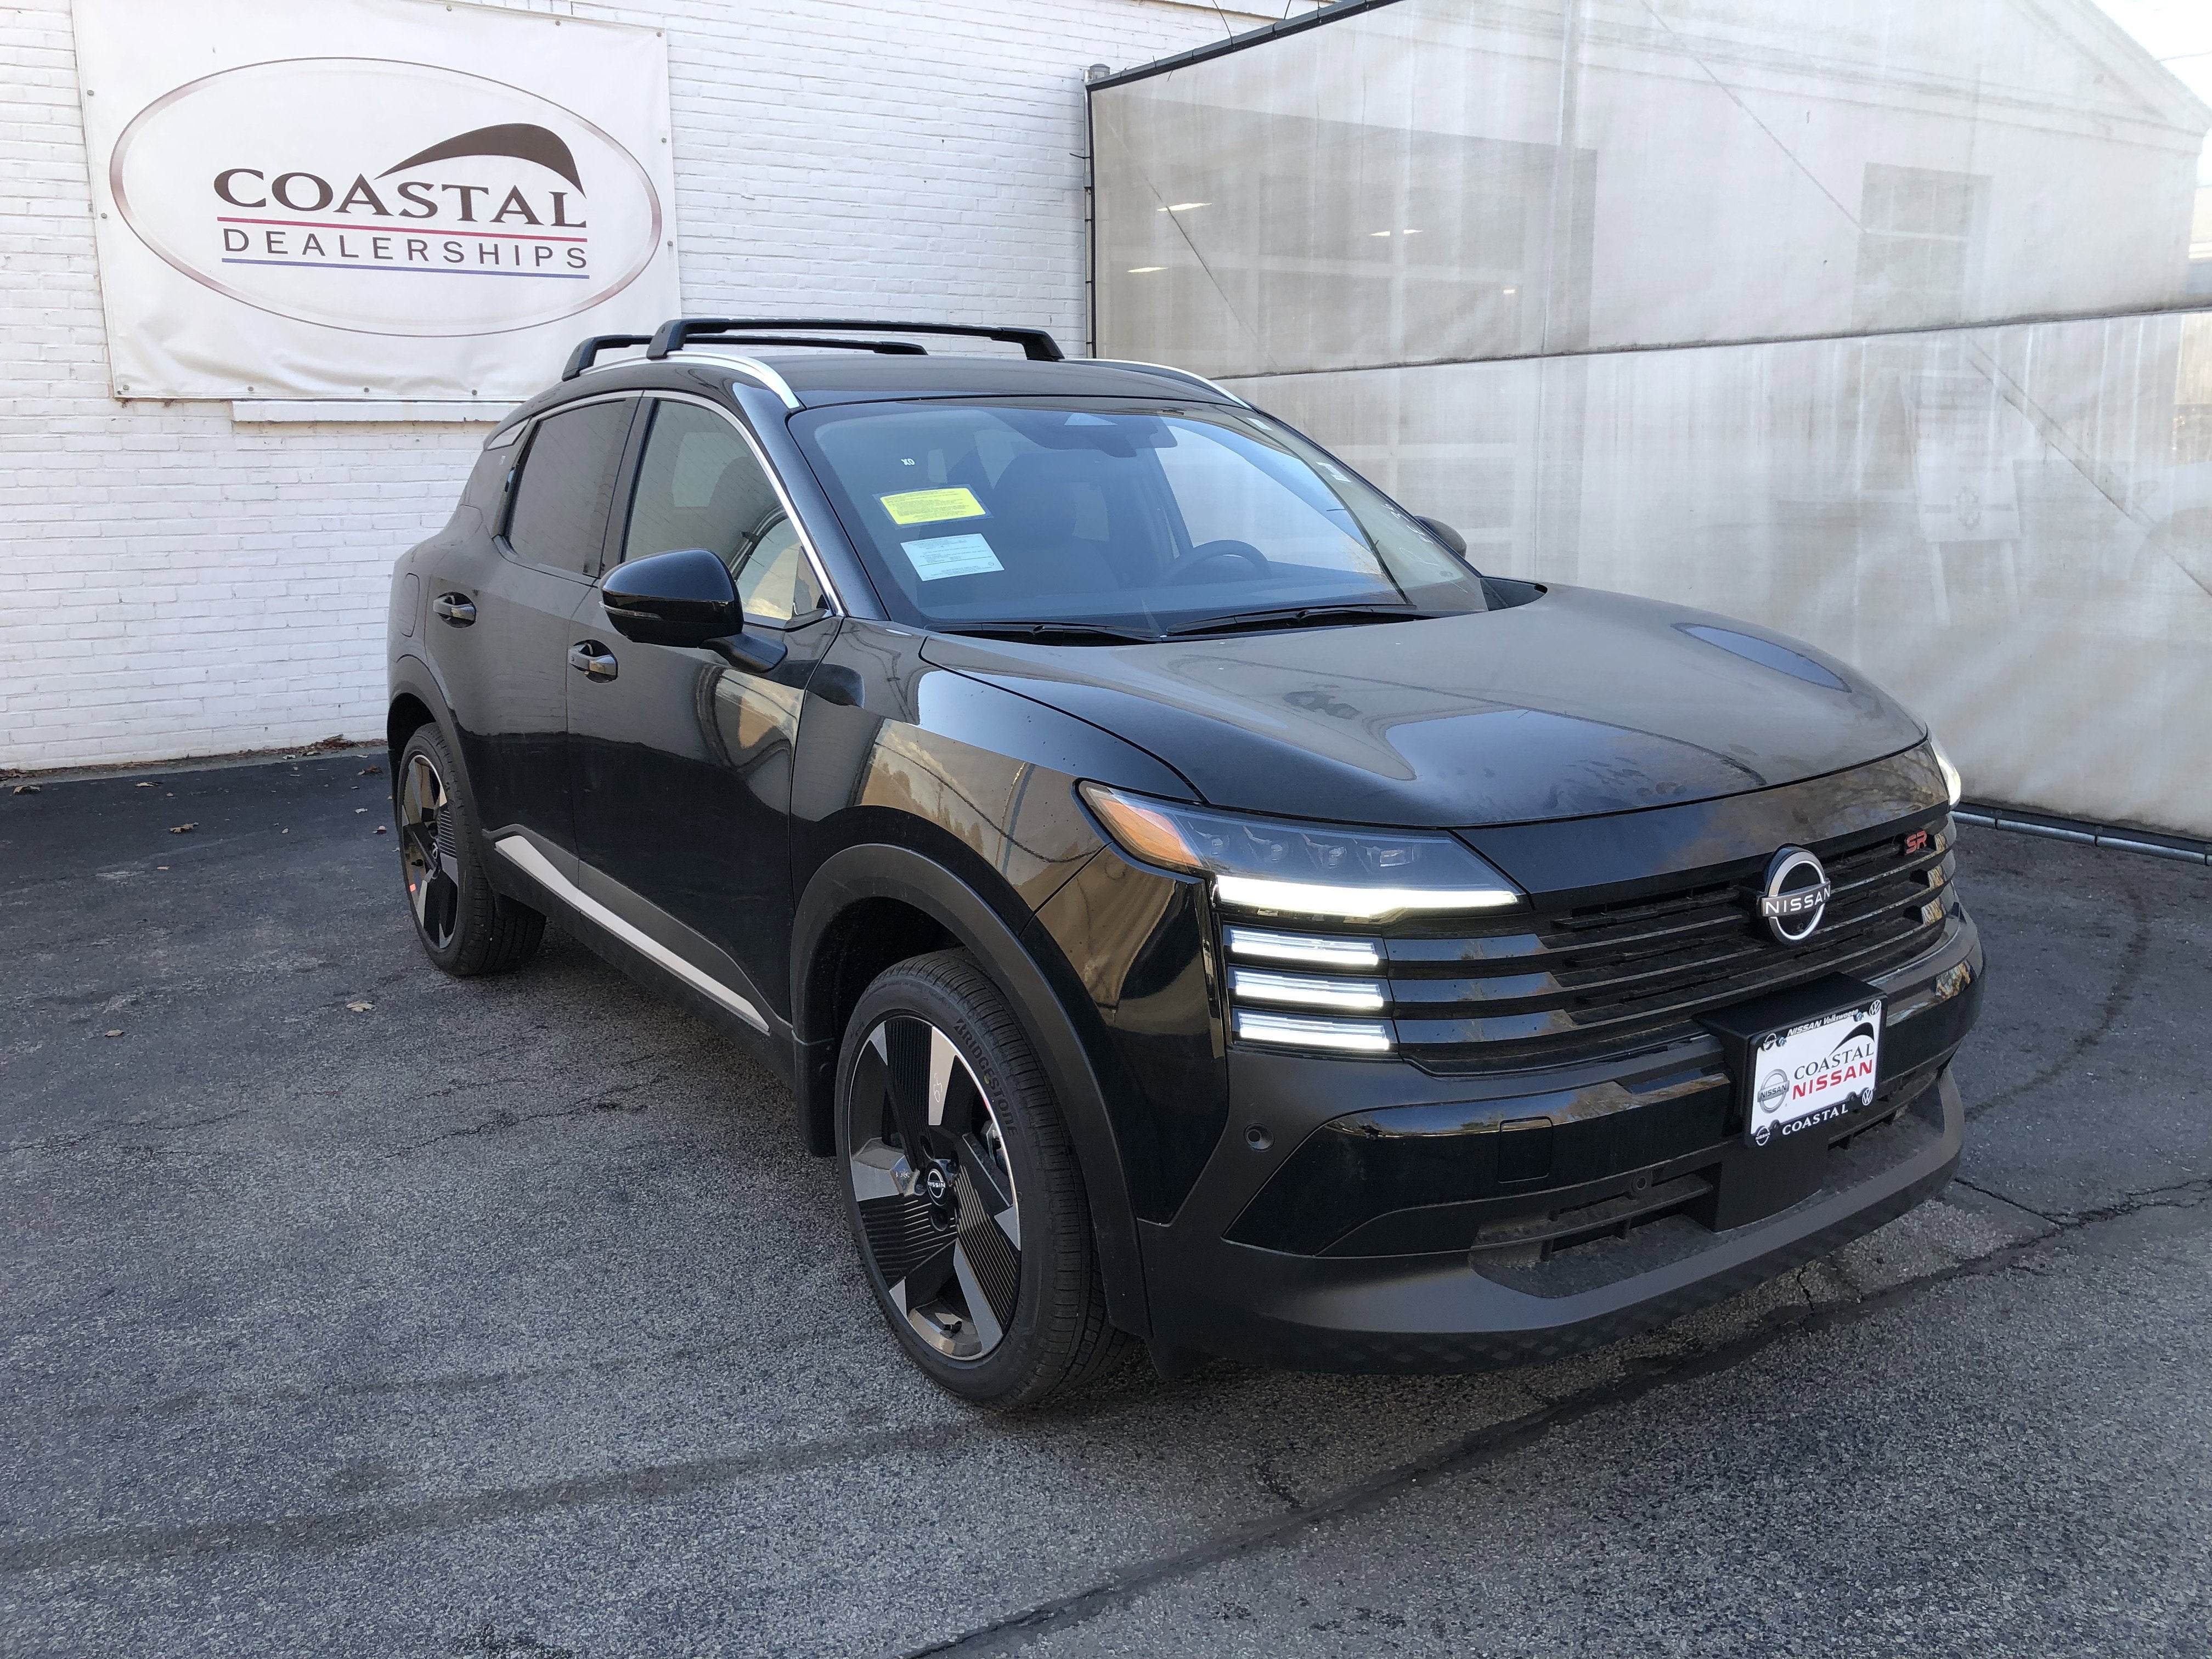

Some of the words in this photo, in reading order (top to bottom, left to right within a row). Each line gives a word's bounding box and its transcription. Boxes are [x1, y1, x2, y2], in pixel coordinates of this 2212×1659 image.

[213, 167, 588, 229] COASTAL
[224, 228, 588, 269] DEALERSHIPS
[1906, 830, 1927, 854] SR
[1765, 887, 1831, 915] NISSAN
[1787, 1020, 1822, 1037] NISSAN
[1823, 1009, 1859, 1025] Volkswagen
[953, 1018, 1019, 1137] BRIDGESTONE
[1793, 1043, 1874, 1080] COASTAL
[1760, 1084, 1787, 1099] NISSAN
[1792, 1059, 1873, 1100] NISSAN
[1782, 1103, 1848, 1136] COASTAL
